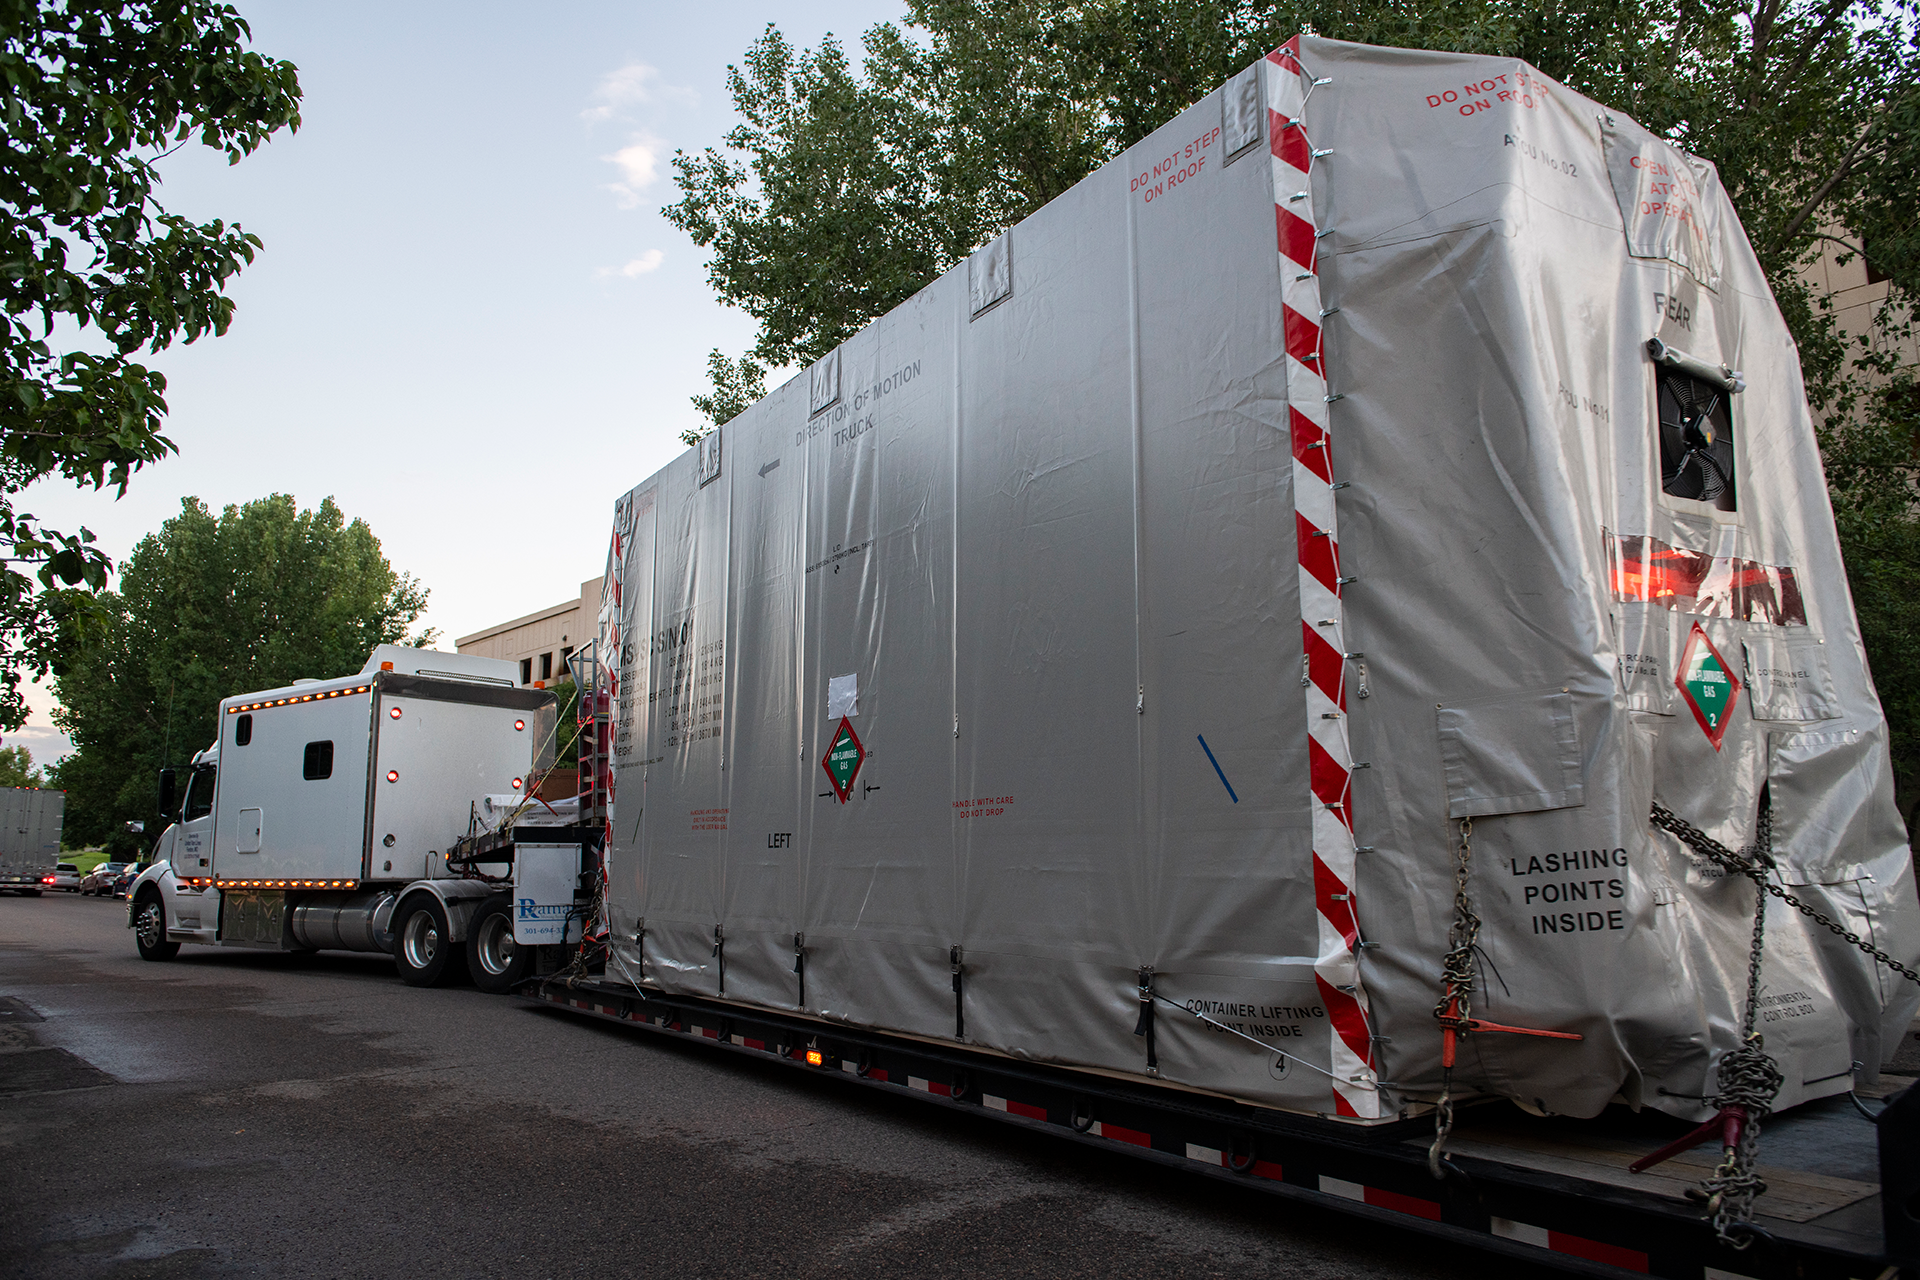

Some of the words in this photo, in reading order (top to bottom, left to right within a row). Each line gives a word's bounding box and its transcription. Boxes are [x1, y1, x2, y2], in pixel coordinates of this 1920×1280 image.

[1426, 90, 1458, 108] DO
[1464, 74, 1508, 96] NOT
[1514, 72, 1549, 98] STEP
[1459, 98, 1491, 116] ON
[1496, 89, 1540, 112] ROOF
[1130, 172, 1148, 192] DO
[1153, 151, 1180, 179] NOT
[1184, 126, 1220, 159] STEP
[1630, 156, 1670, 177] OPEN
[1144, 182, 1163, 203] ON
[1168, 156, 1206, 190] ROOF
[1650, 182, 1688, 202] ATCU
[1654, 292, 1692, 332] REAR
[796, 402, 850, 447] DIRECTION
[854, 390, 869, 411] OF
[874, 359, 920, 401] MOTION
[834, 413, 873, 447] TRUCK
[714, 640, 723, 652] KG
[620, 685, 633, 697] ATED
[714, 656, 723, 667] KG
[714, 672, 722, 683] KG
[1704, 686, 1716, 698] GAS
[619, 718, 635, 729] ENGTH
[1710, 713, 1717, 727] 2
[840, 761, 848, 770] GAS
[842, 780, 846, 789] 2
[952, 799, 975, 808] HANDLE
[996, 796, 1014, 804] CARE
[986, 808, 1004, 816] DROP
[768, 833, 791, 848] LEFT
[1511, 848, 1628, 876] LASHING
[1701, 869, 1723, 877] ATCU
[1524, 879, 1624, 904] POINTS
[1533, 910, 1624, 934] INSIDE
[1186, 999, 1256, 1018] CONTAINER
[1261, 1006, 1324, 1019] LIFTING
[1763, 1007, 1800, 1022] CONTROL
[1798, 1003, 1816, 1015] BOX
[1205, 1020, 1244, 1034] POINT
[1250, 1024, 1303, 1037] INSIDE
[1275, 1054, 1285, 1073] 4
